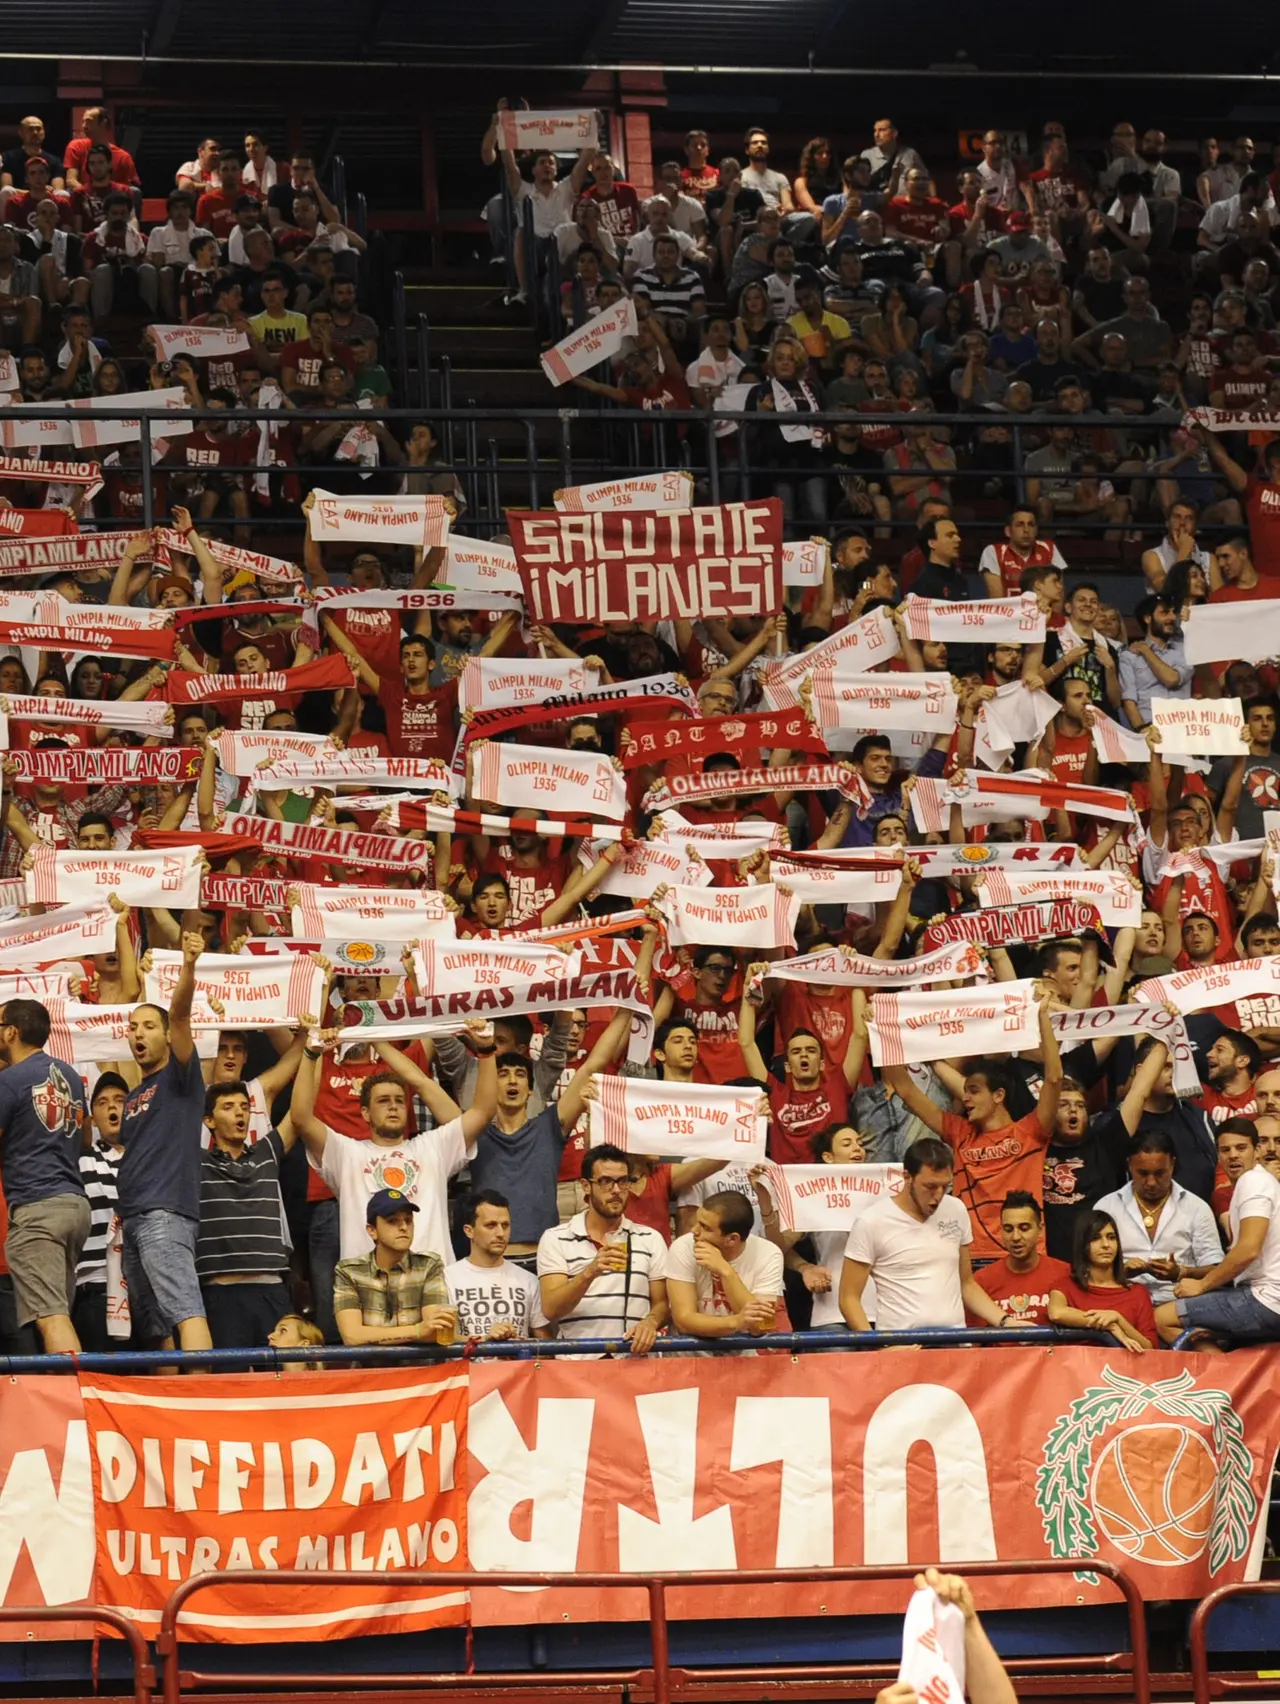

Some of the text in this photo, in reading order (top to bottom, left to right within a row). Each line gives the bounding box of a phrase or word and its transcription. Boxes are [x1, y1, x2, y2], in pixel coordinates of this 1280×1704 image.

[186, 447, 220, 465] RED
[585, 482, 657, 505] OLIMPIA MILANO
[612, 495, 633, 506] 1936
[521, 503, 775, 564] SALUTATE
[454, 552, 489, 566] OLIMPIA
[477, 565, 497, 578] 1936
[397, 593, 455, 608] 1936
[935, 604, 973, 617] OLIMPIA
[66, 613, 104, 628] OLIMPIA
[962, 614, 984, 626] 1936
[9, 627, 112, 650] OLIMPIA MILANO
[185, 674, 286, 701] OLIMPIA MILANO
[488, 676, 524, 691] OLIMPIA
[640, 681, 690, 698] 1936
[514, 688, 535, 699] 1936
[54, 700, 103, 723] MILANO
[241, 700, 275, 717] RED
[1185, 725, 1210, 736] 1936
[241, 735, 316, 756] OLIMPIA MILANO
[14, 750, 181, 780] OLIMPIAMILANO
[533, 778, 557, 791] 1936
[551, 766, 589, 786] MILANO
[64, 859, 110, 874] OLIMPIA
[324, 898, 366, 912] OLIMPIA
[444, 954, 536, 976] OLIMPIA MILANO
[922, 956, 952, 974] 1936
[1171, 965, 1216, 988] OLIMPIA
[1204, 976, 1231, 991] 1936
[378, 987, 514, 1020] ULTRAS
[906, 1007, 996, 1030] OLIMPIA MILANO
[635, 1105, 680, 1121] OLIMPIA
[668, 1120, 694, 1134] 1936
[794, 1177, 838, 1198] OLIMPIA
[455, 1284, 526, 1300] PELÈ IS
[457, 1301, 526, 1317] GOOD
[96, 1421, 458, 1515] DIFFIDATI
[107, 1518, 460, 1580] ULTRAS MILANO
